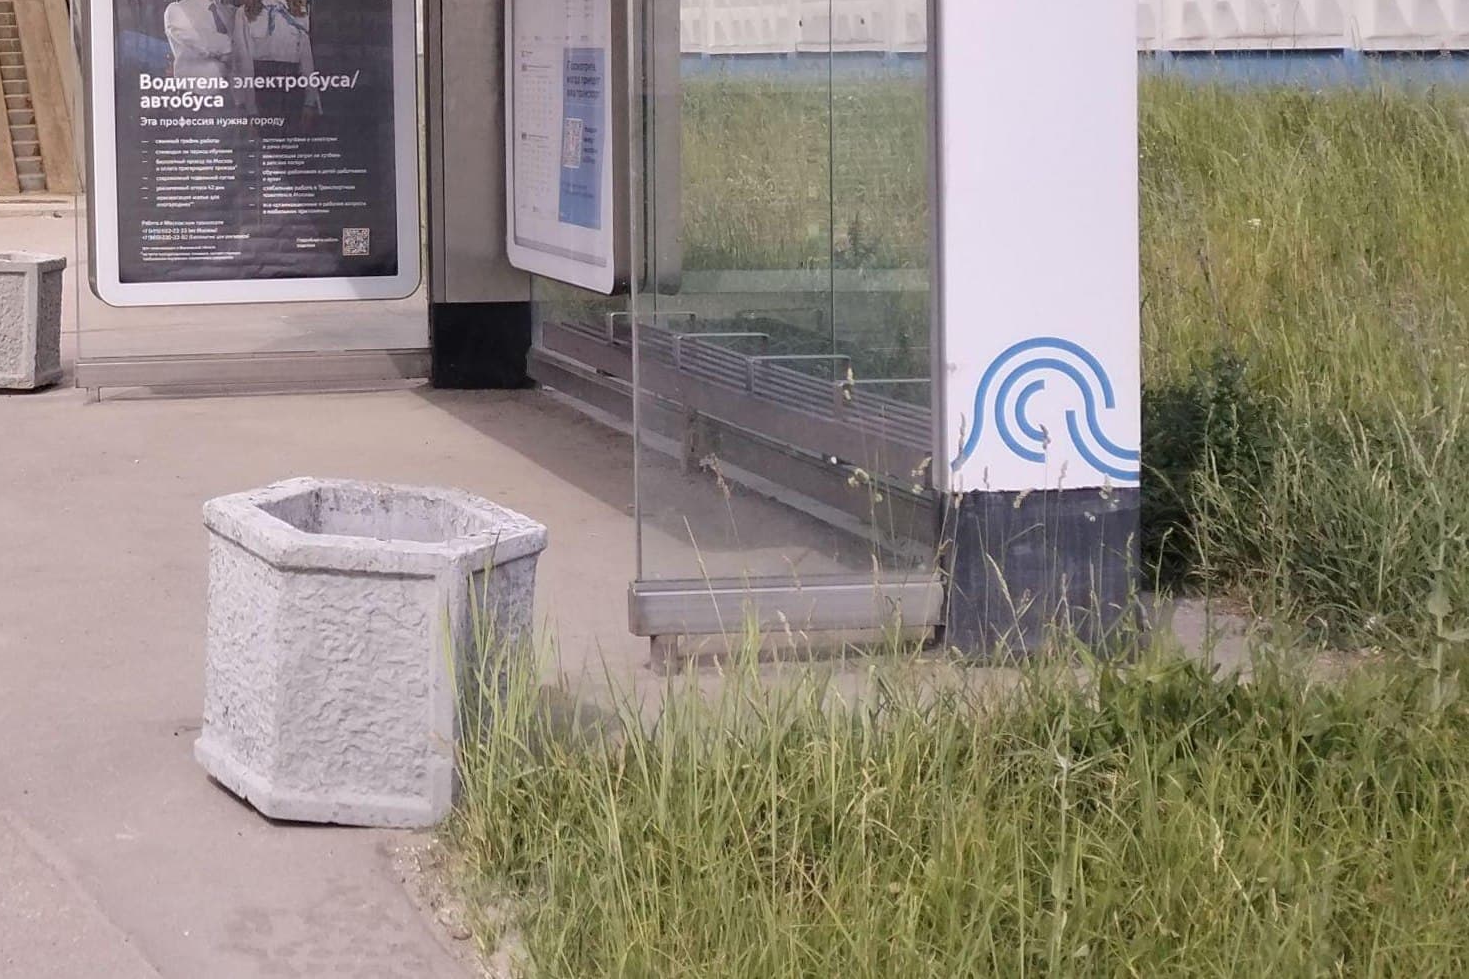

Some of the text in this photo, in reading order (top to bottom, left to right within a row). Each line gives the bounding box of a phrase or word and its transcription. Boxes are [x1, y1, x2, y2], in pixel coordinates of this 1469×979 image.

[139, 70, 360, 92] Водитель электробуса/
[140, 92, 224, 111] автобуса
[140, 116, 285, 128] Эта профессия нужна городу
